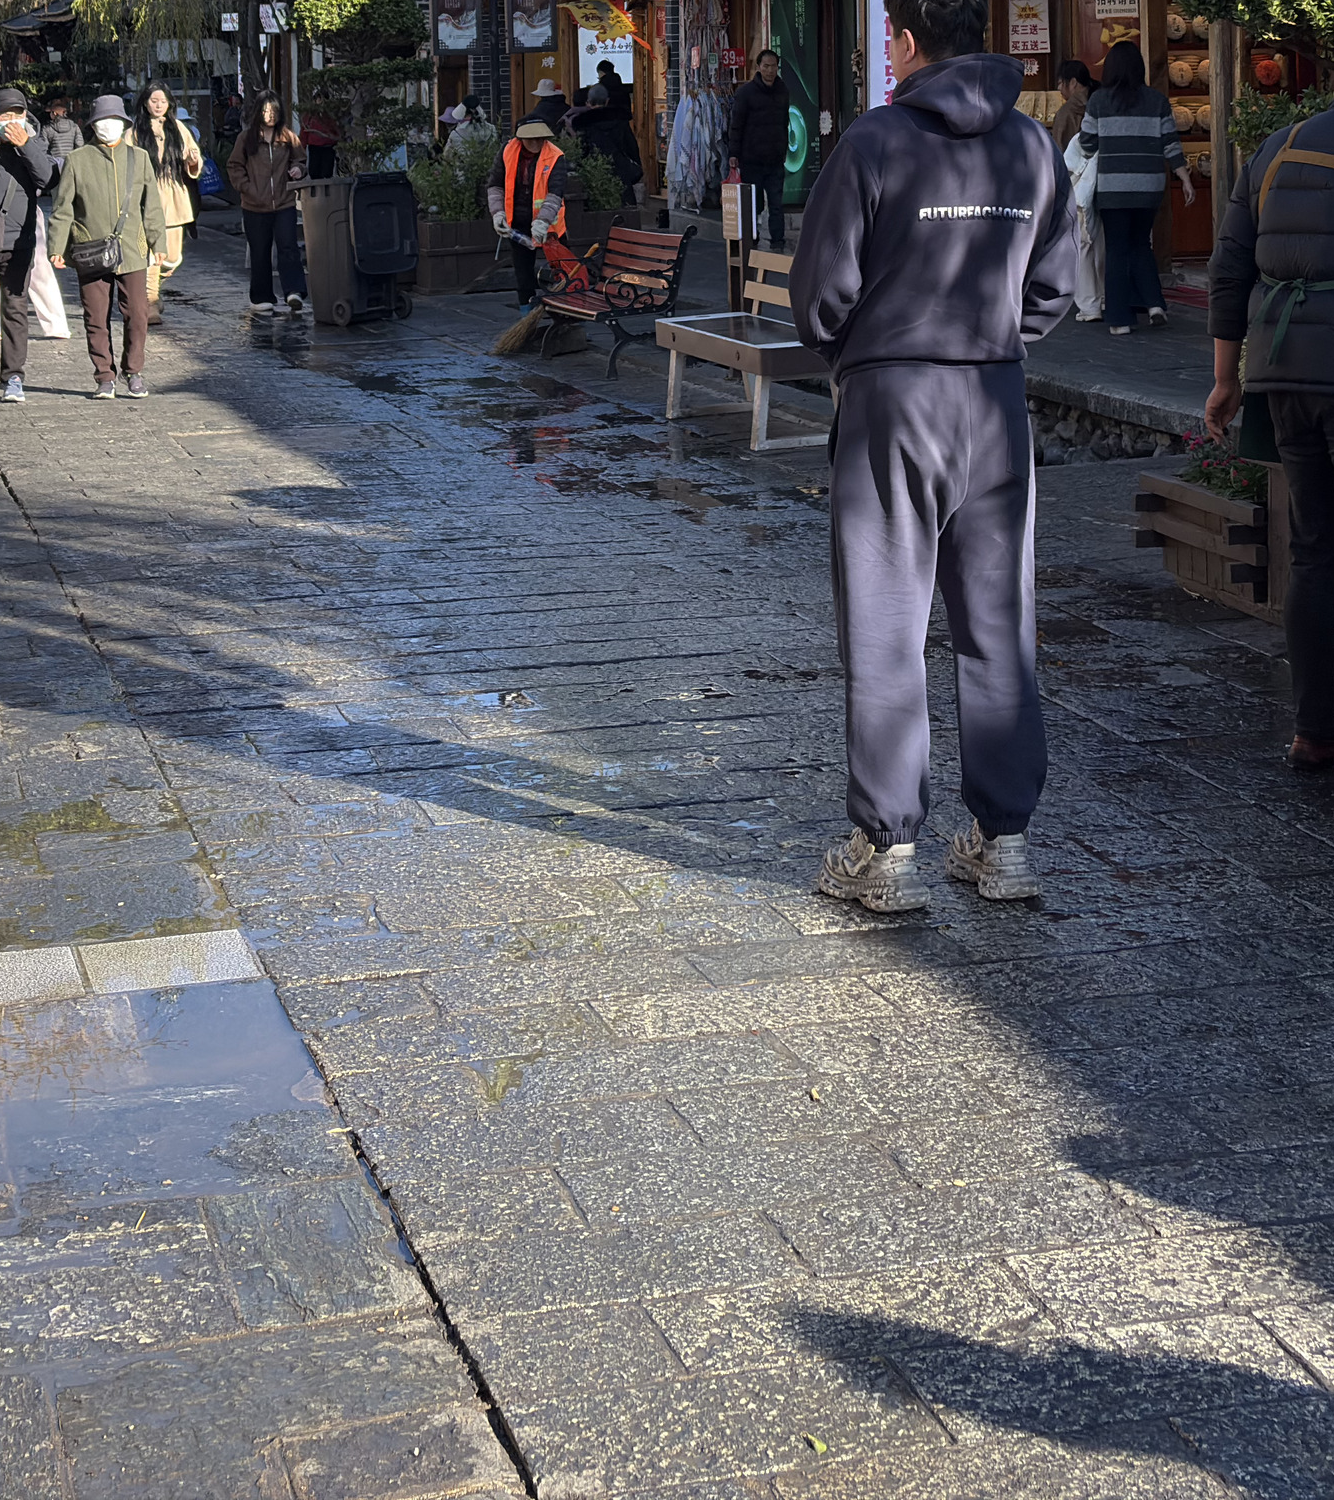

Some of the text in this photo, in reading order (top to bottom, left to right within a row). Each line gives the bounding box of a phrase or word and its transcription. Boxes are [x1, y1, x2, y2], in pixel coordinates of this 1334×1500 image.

[1011, 24, 1048, 36] 买三送一
[1011, 40, 1049, 52] 买五送二
[722, 50, 736, 64] 39
